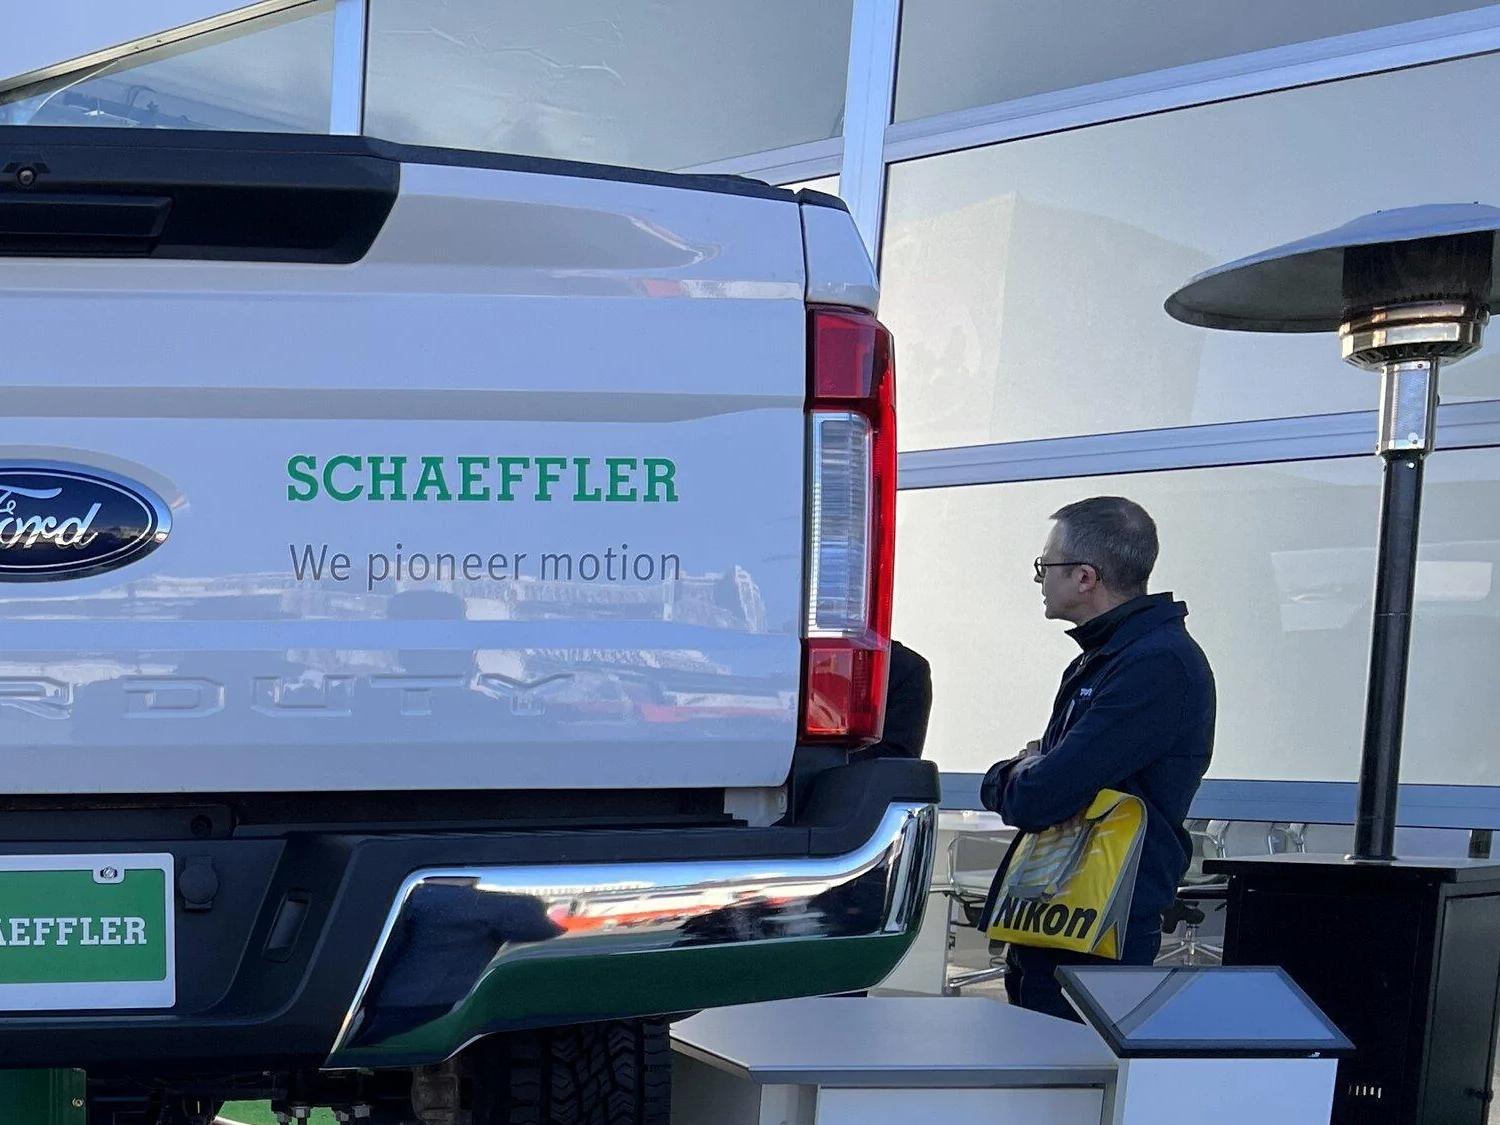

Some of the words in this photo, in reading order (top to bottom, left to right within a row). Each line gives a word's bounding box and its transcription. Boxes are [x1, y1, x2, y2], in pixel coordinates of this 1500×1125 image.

[286, 454, 679, 503] SCHAEFFLER
[288, 543, 352, 582] We
[367, 543, 527, 591] pioneer
[540, 543, 682, 582] motion
[122, 673, 576, 719] DUTY
[992, 893, 1098, 940] Nikon
